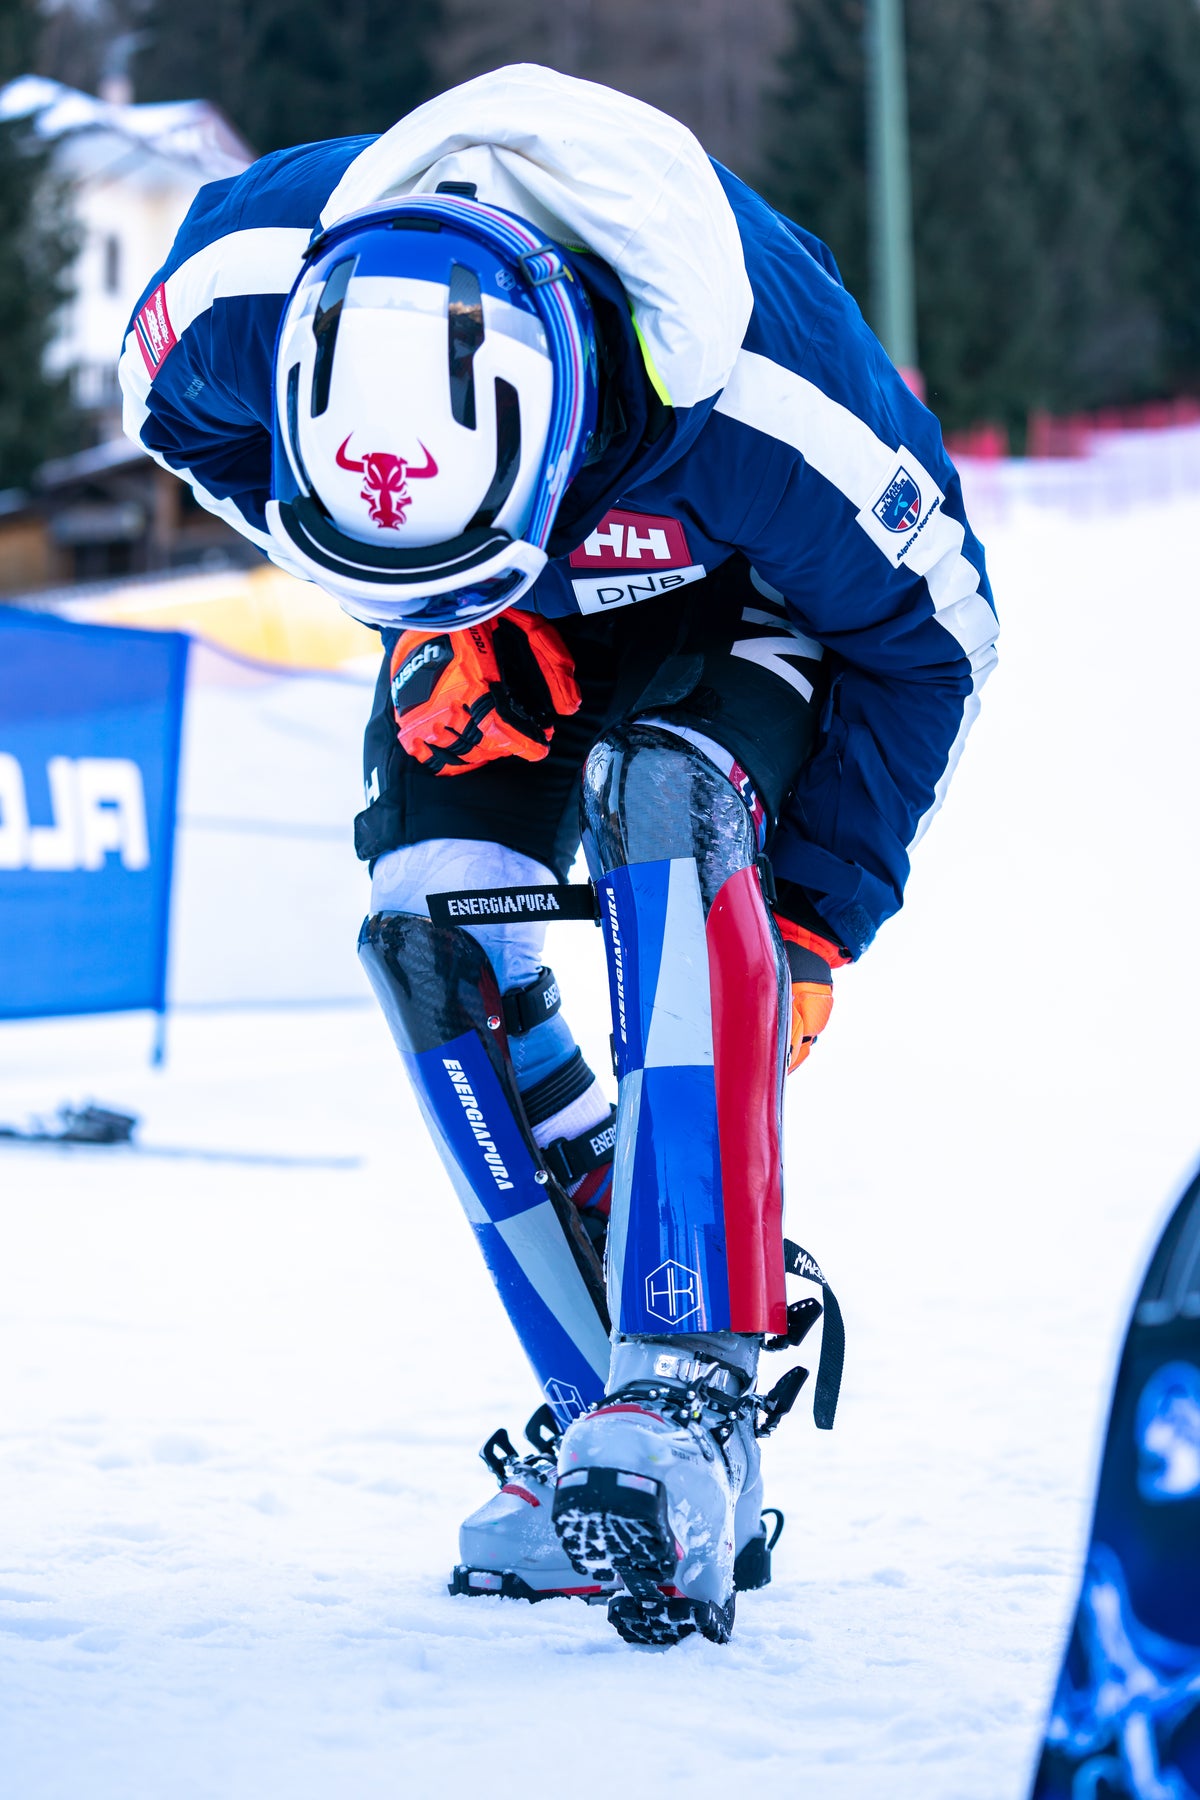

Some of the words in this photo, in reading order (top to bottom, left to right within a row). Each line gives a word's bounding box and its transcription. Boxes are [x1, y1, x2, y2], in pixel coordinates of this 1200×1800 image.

[584, 523, 671, 560] HH
[897, 532, 918, 560] Alpine
[917, 496, 940, 532] Norway
[596, 574, 685, 605] DNB
[447, 893, 560, 917] ENERGIAPURA
[605, 887, 628, 1045] ENERGIAPURA
[442, 1058, 515, 1191] ENERGIAPURA
[589, 1123, 616, 1157] ENER
